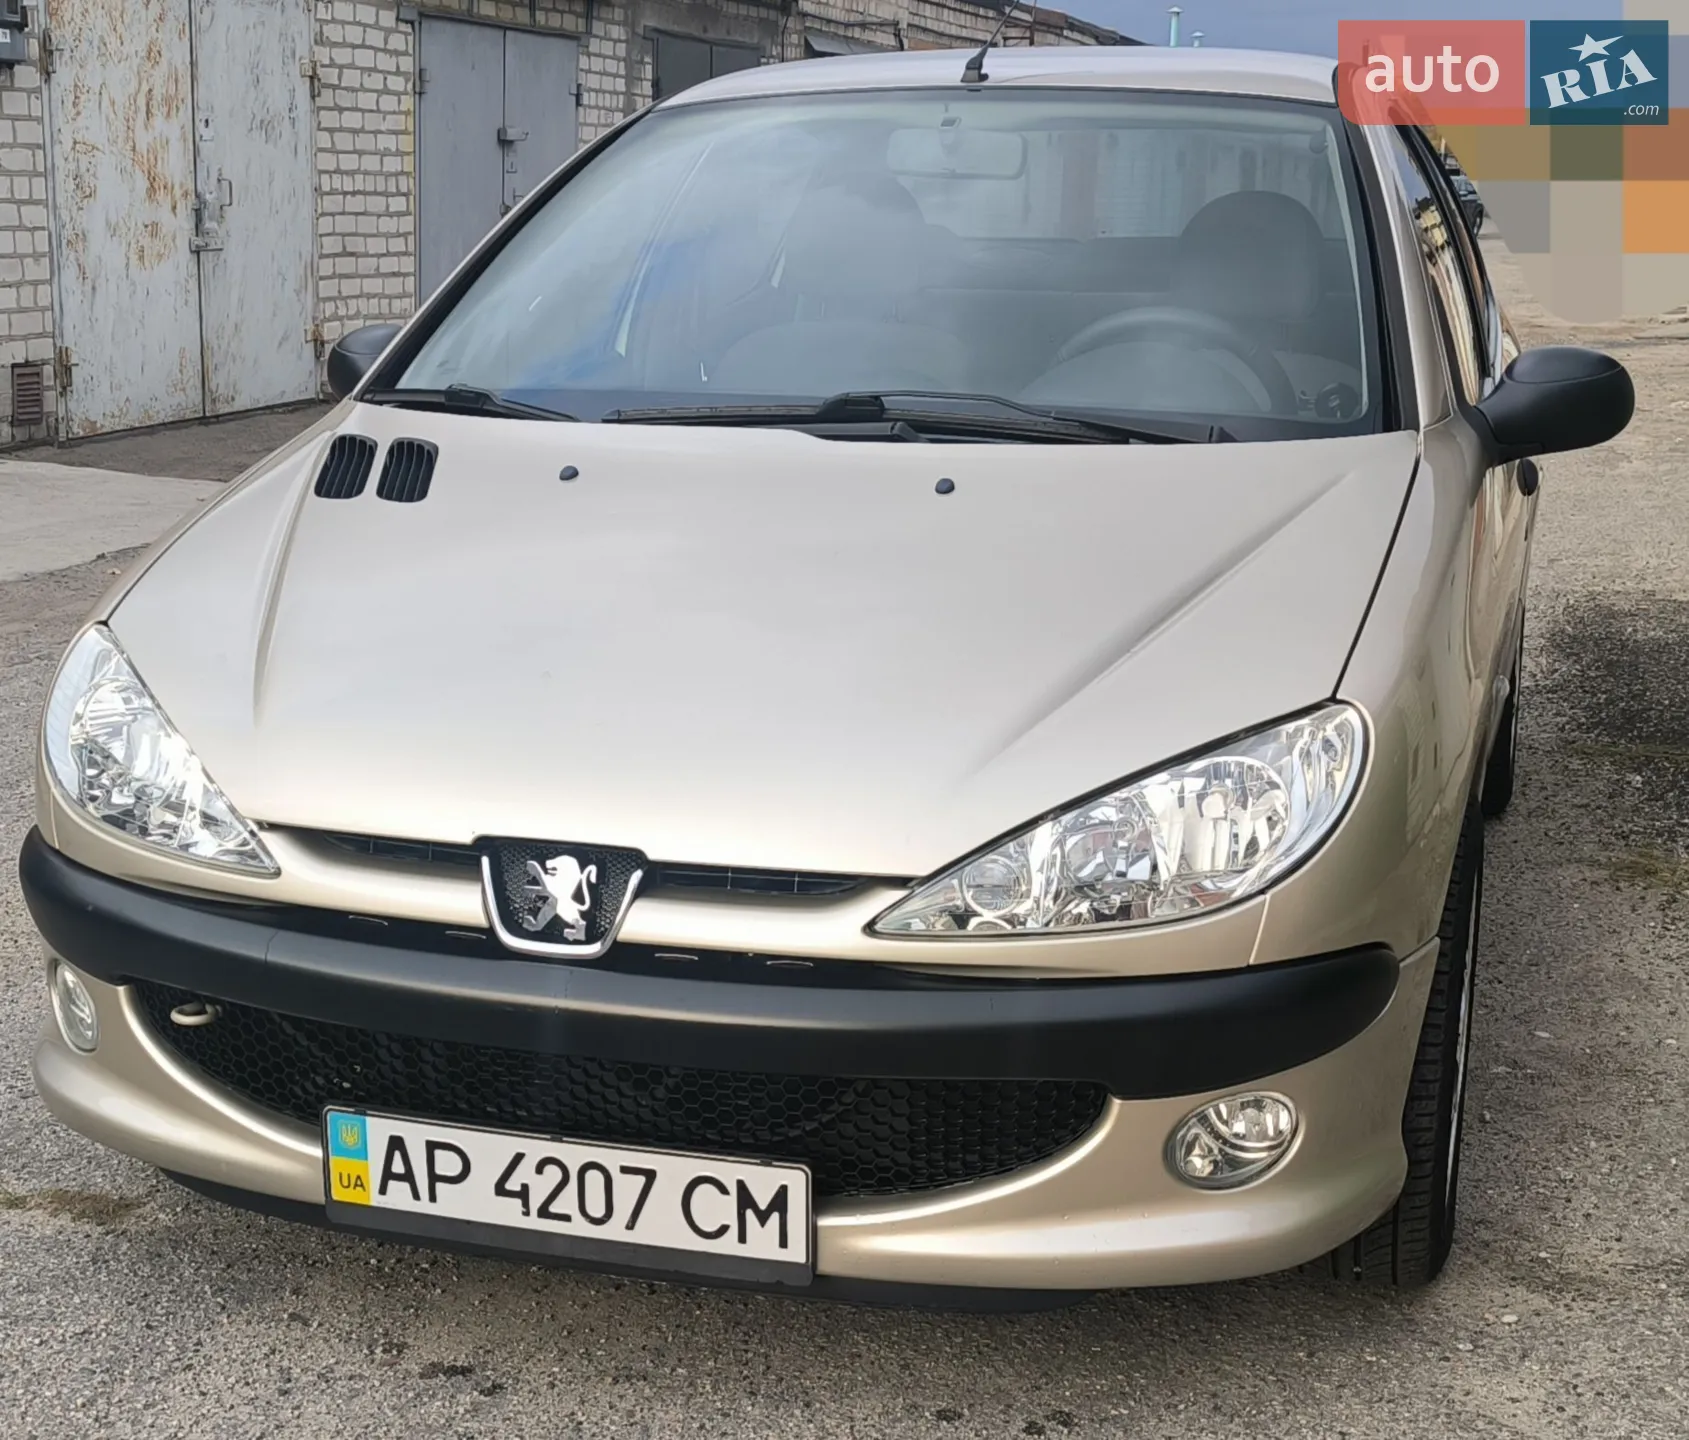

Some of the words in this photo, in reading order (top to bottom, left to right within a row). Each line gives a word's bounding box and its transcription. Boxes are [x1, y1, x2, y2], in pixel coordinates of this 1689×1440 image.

[338, 1171, 366, 1192] UA
[377, 1134, 471, 1204] AP
[494, 1152, 657, 1231] 4207
[680, 1175, 788, 1249] CM
